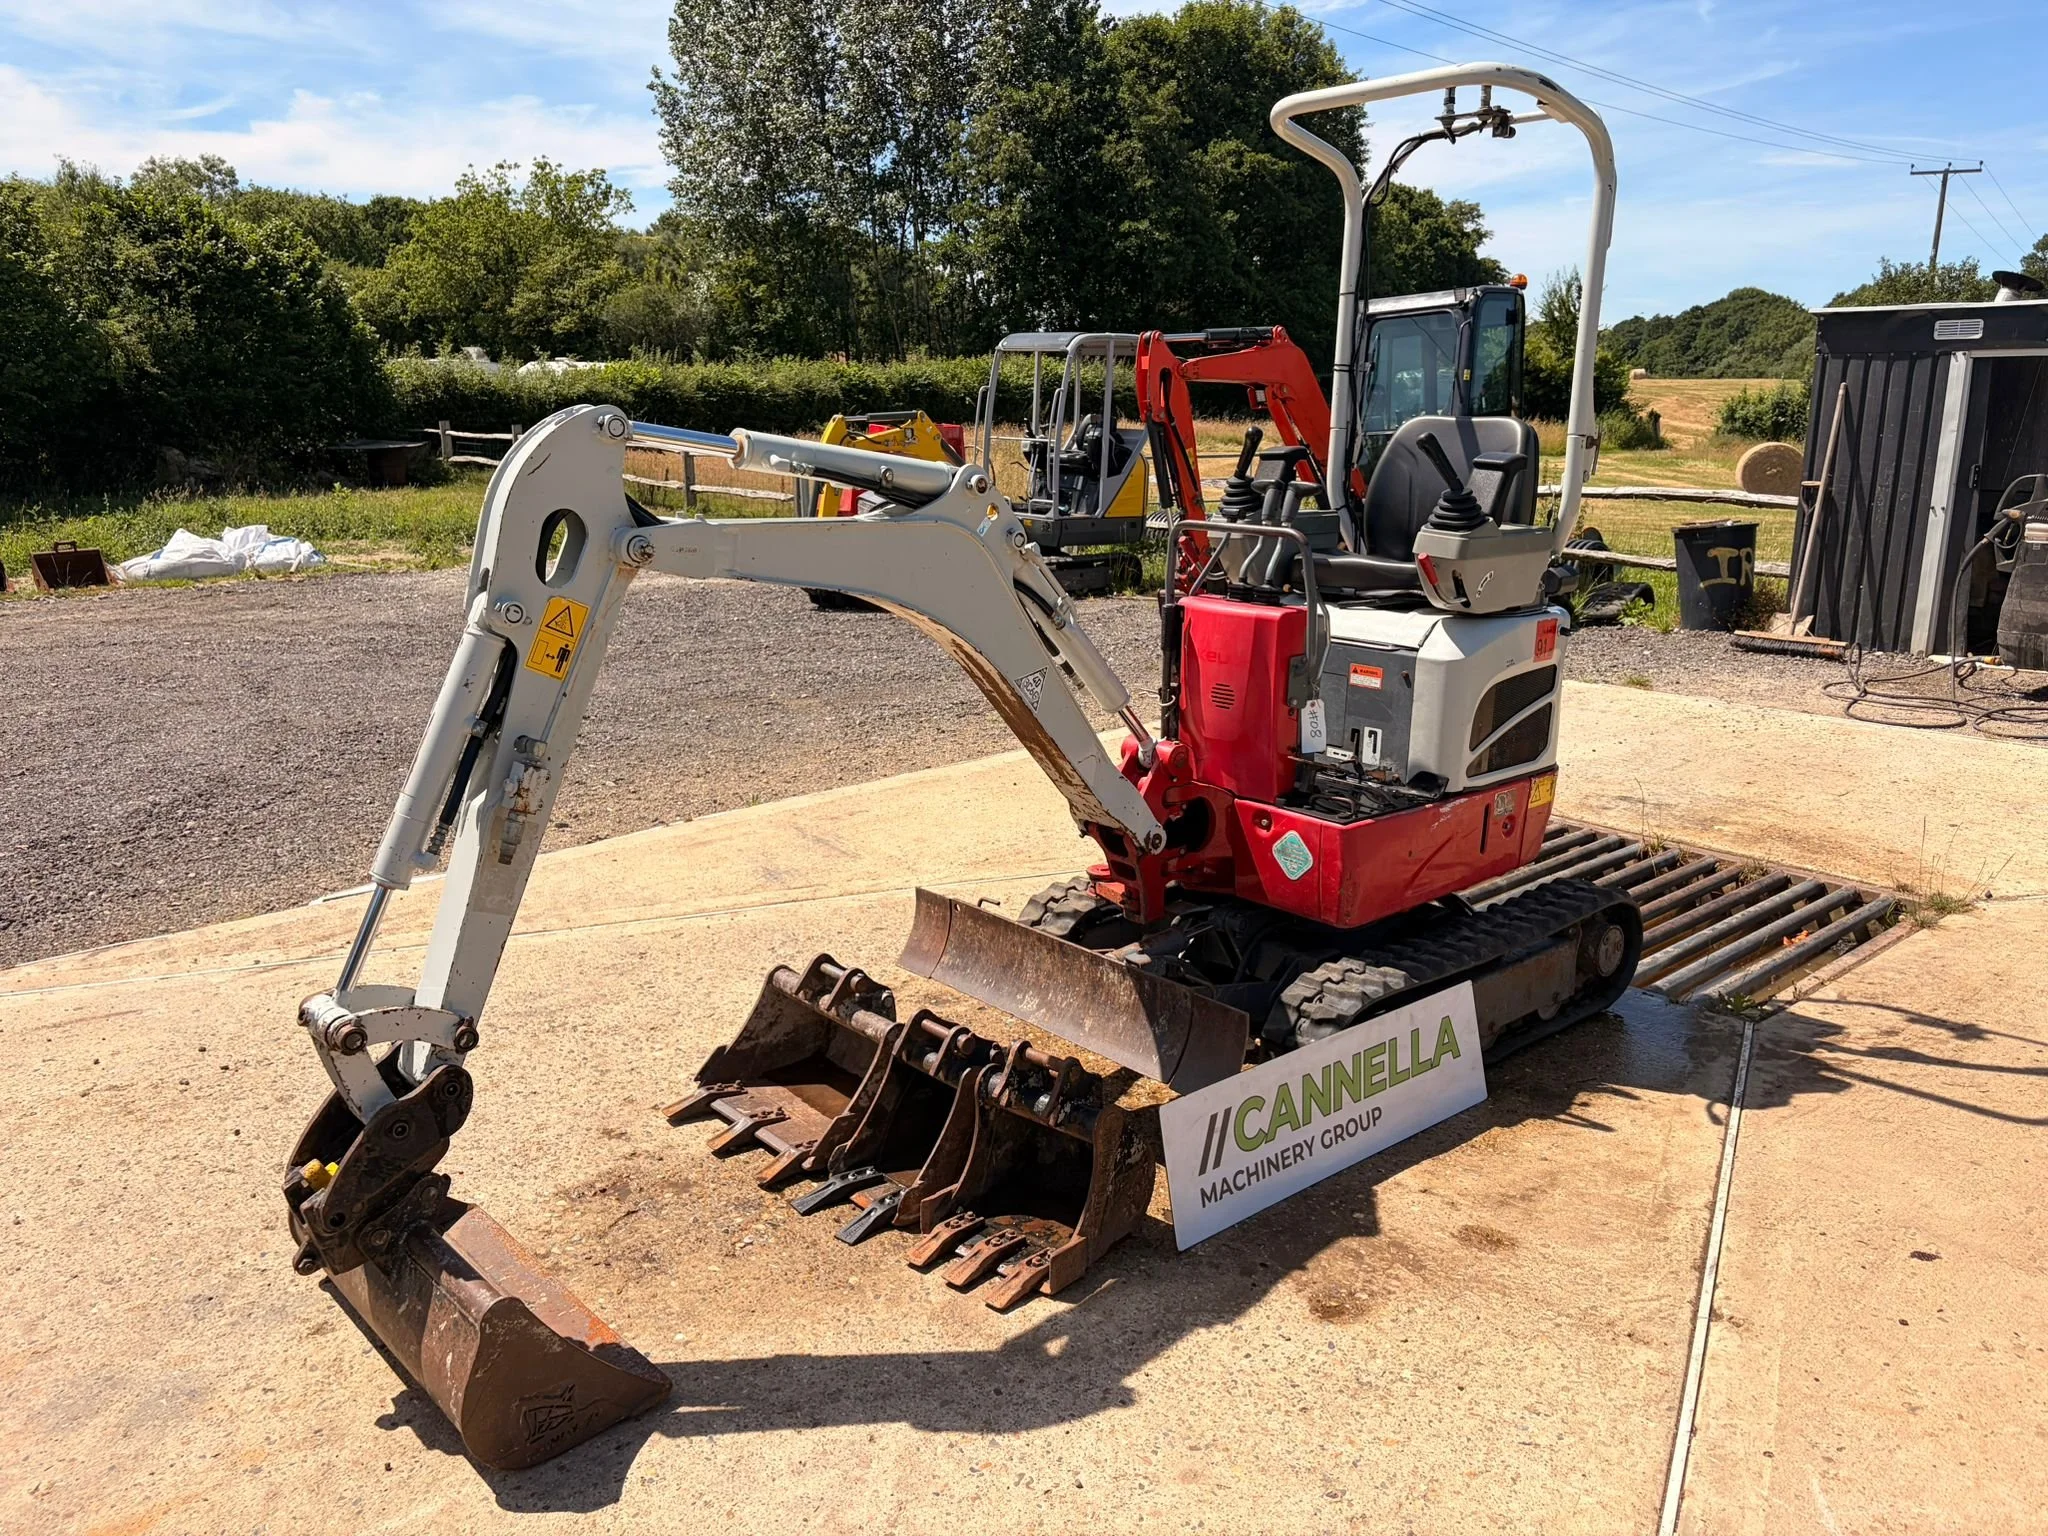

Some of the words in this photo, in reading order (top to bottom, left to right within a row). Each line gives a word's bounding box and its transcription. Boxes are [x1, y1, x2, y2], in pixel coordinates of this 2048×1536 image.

[1234, 1015, 1462, 1152] CANNELLA
[1199, 1136, 1316, 1208] MACHINERY
[1321, 1106, 1383, 1150] GROUP
